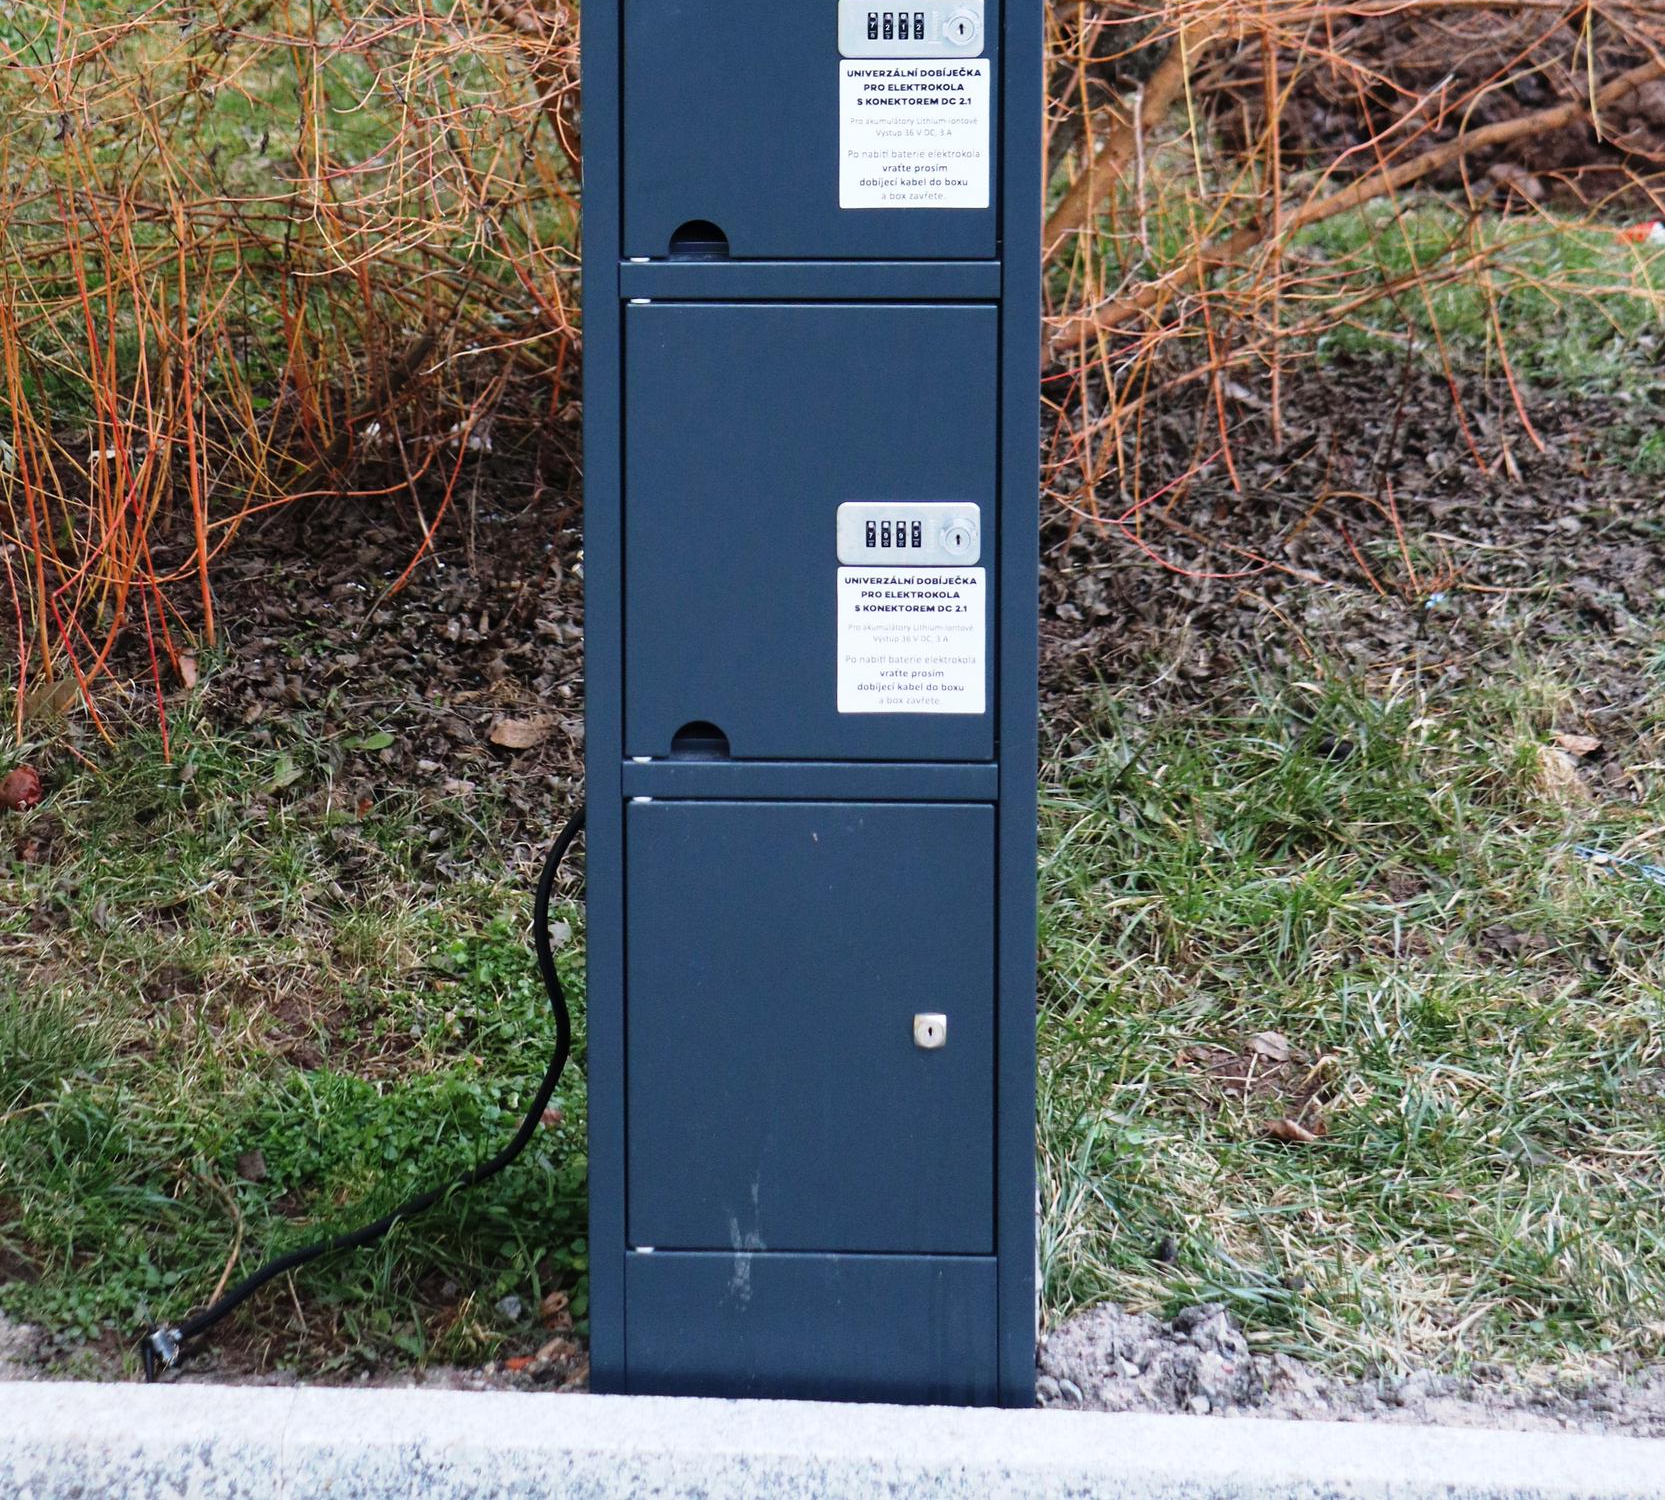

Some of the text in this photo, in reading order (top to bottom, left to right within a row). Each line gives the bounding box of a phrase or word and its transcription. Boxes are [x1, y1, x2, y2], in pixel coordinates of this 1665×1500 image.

[847, 67, 982, 78] UNIVERZÁLNÍ DOBÍJEČKA
[863, 83, 964, 92] PRO ELEKTROKOLA
[857, 98, 863, 106] S
[865, 98, 939, 106] KONEKTOREM
[866, 118, 914, 126] akumulátory
[848, 149, 980, 158] Po nabití baterie elektrokola
[882, 163, 948, 174] vraťte prosím
[859, 178, 968, 188] dobíjecí kabel do boxu
[844, 575, 977, 585] UNIVERZÁLNÍ DOBÍJEČKA
[861, 591, 960, 599] PRO ELEKTROKOLA
[863, 604, 935, 613] KONEKTOREM
[937, 604, 953, 612] DC
[955, 604, 968, 612] 2.1
[863, 624, 911, 632] akumulátory
[846, 655, 975, 663] Po nabití baterie elektrokola
[880, 668, 944, 678] vraťte prosím
[857, 682, 964, 692] dobíjecí kabel do boxu
